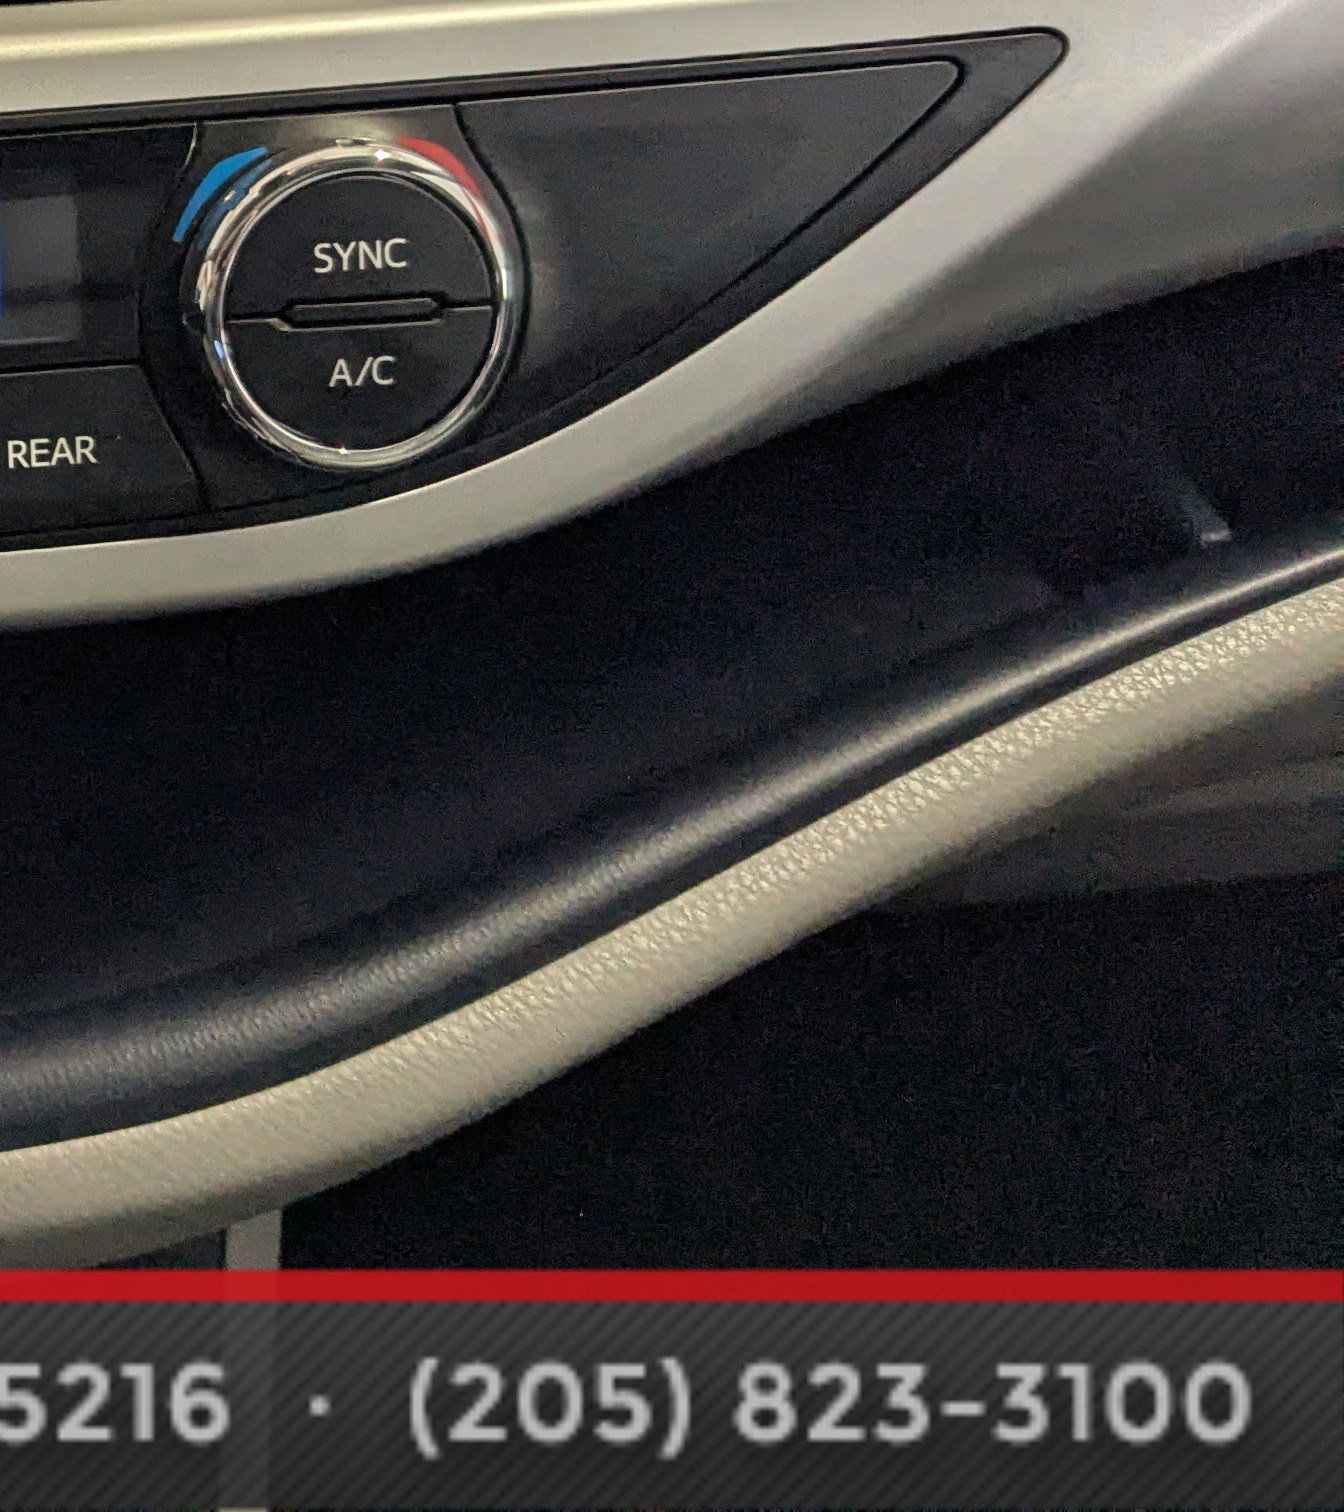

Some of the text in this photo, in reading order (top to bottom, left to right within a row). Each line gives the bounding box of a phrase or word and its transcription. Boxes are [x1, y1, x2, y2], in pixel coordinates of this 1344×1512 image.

[313, 237, 408, 274] SYNC
[328, 355, 398, 388] A/C
[7, 435, 99, 469] REAR
